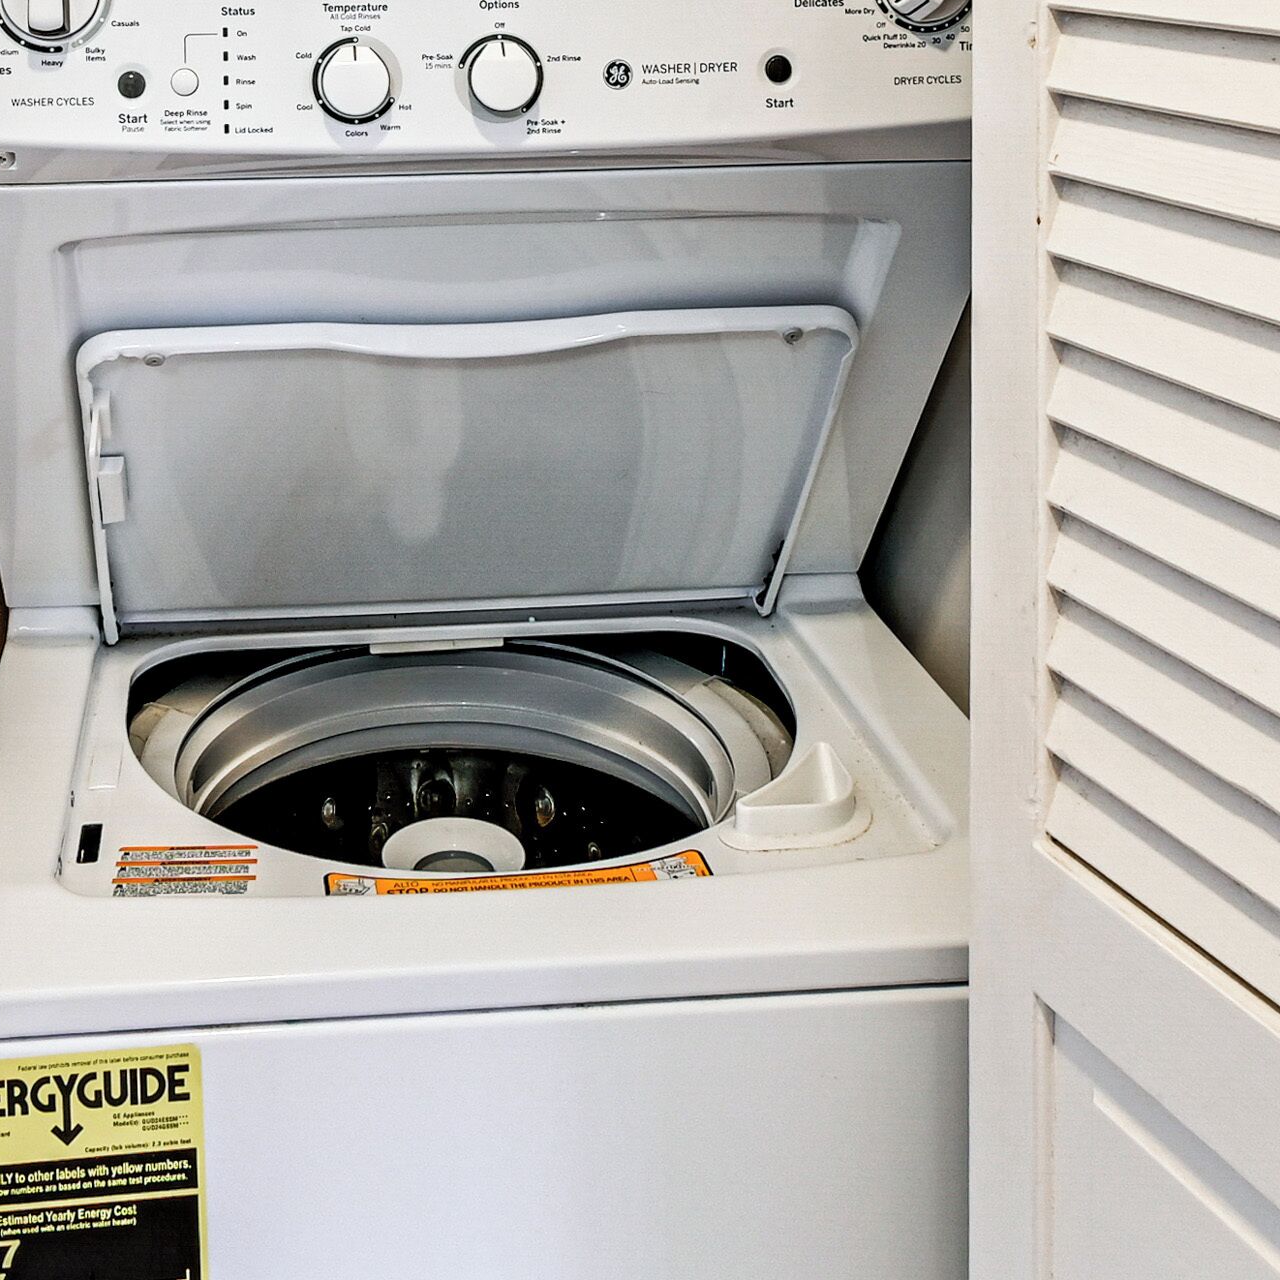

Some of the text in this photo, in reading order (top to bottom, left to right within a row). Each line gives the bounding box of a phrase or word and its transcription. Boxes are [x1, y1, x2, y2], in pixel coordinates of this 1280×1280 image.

[322, 3, 388, 13] Temperature
[479, 0, 520, 11] Options
[221, 6, 255, 16] Status
[863, 7, 875, 16] Dry
[960, 25, 970, 33] 50
[862, 34, 881, 42] Quick
[883, 33, 898, 41] Fluff
[945, 33, 956, 41] 40
[85, 47, 106, 55] Bulky
[41, 59, 64, 67] Heavy
[425, 62, 433, 70] 15
[641, 62, 738, 74] WASHER DRYER
[675, 77, 700, 85] Sensing
[894, 75, 962, 86] DRYER CYCLES
[11, 96, 95, 107] WASHER CYCLES
[765, 97, 794, 109] Start
[118, 113, 148, 124] Start
[164, 109, 185, 118] Deep
[121, 125, 145, 133] Pause
[345, 129, 369, 138] Colors
[526, 127, 540, 135] 2nd
[528, 879, 572, 888] PRODUCT
[606, 875, 631, 883] AREA
[15, 1172, 26, 1183] to
[27, 1170, 54, 1182] other
[55, 1166, 86, 1180] labels
[87, 1165, 110, 1177] with
[110, 1162, 144, 1178] yellow
[145, 1159, 192, 1172] numbers.
[10, 1185, 44, 1195] numbers
[44, 1184, 57, 1192] are
[58, 1181, 81, 1192] based
[82, 1181, 93, 1189] on
[93, 1179, 106, 1188] the
[107, 1178, 128, 1187] same
[128, 1176, 143, 1185] test
[143, 1172, 189, 1185] procedures.
[45, 1210, 76, 1223] Yearly
[77, 1207, 112, 1221] Energy
[113, 1204, 137, 1216] Cost
[0, 1216, 137, 1238] (when used with an electric water heater)
